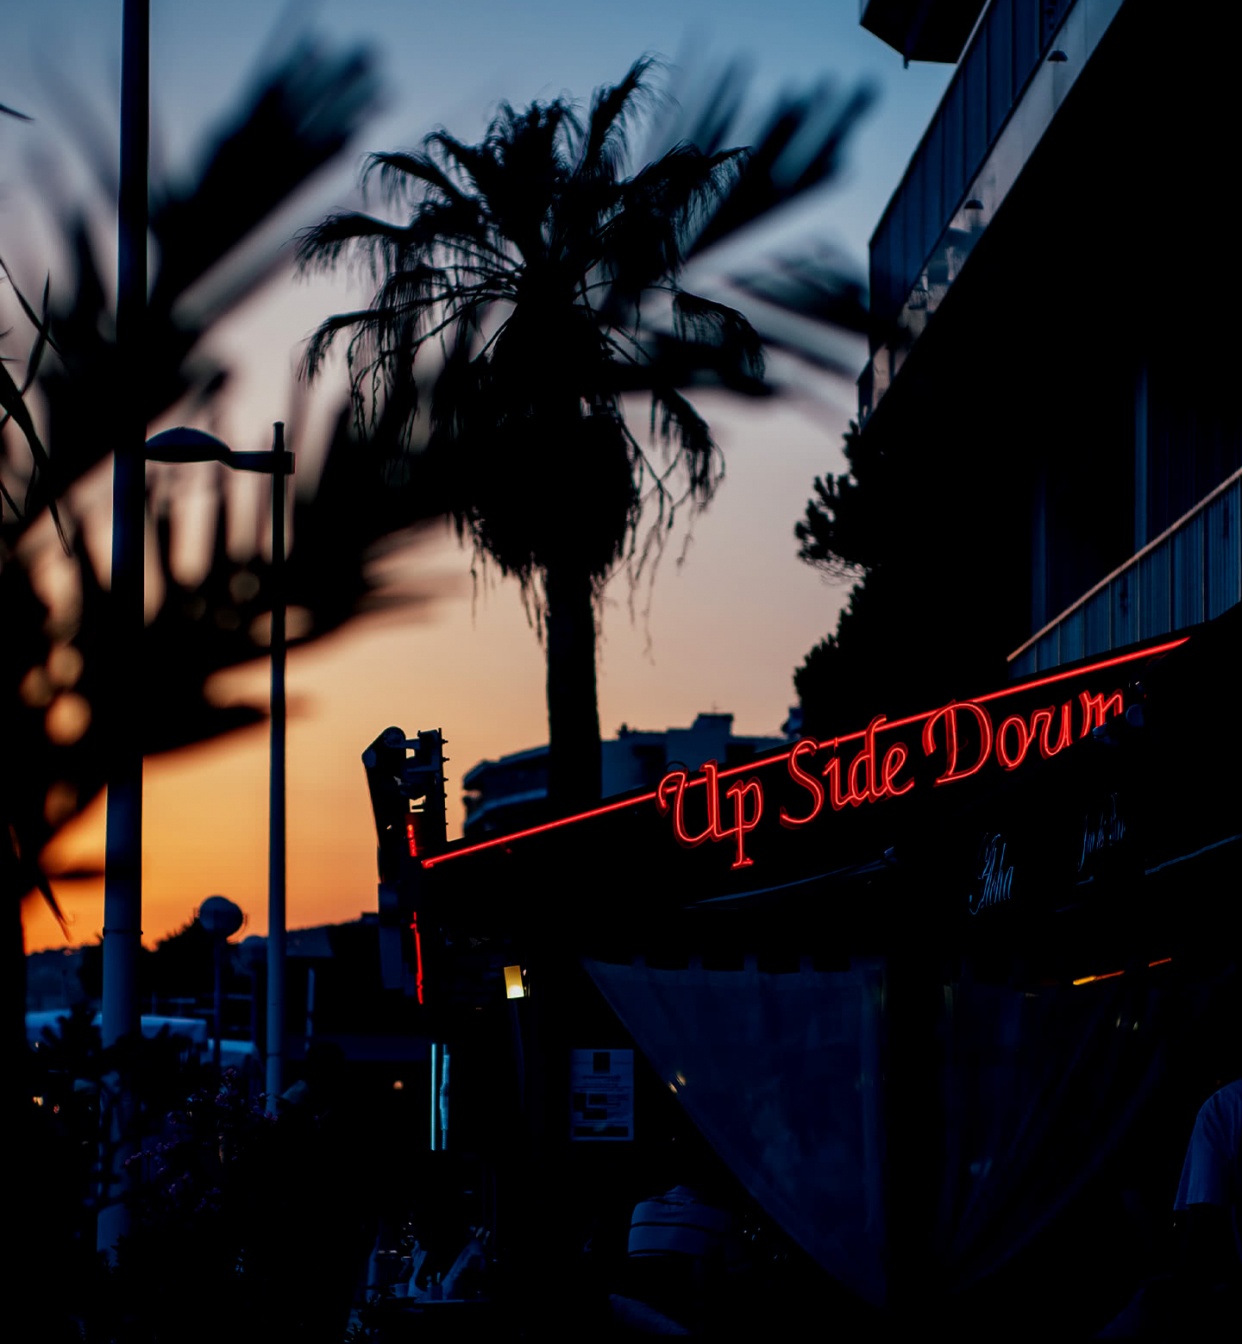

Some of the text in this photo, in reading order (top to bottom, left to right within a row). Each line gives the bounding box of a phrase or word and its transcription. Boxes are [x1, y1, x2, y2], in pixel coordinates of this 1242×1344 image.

[656, 689, 1124, 871] Up Side Down
